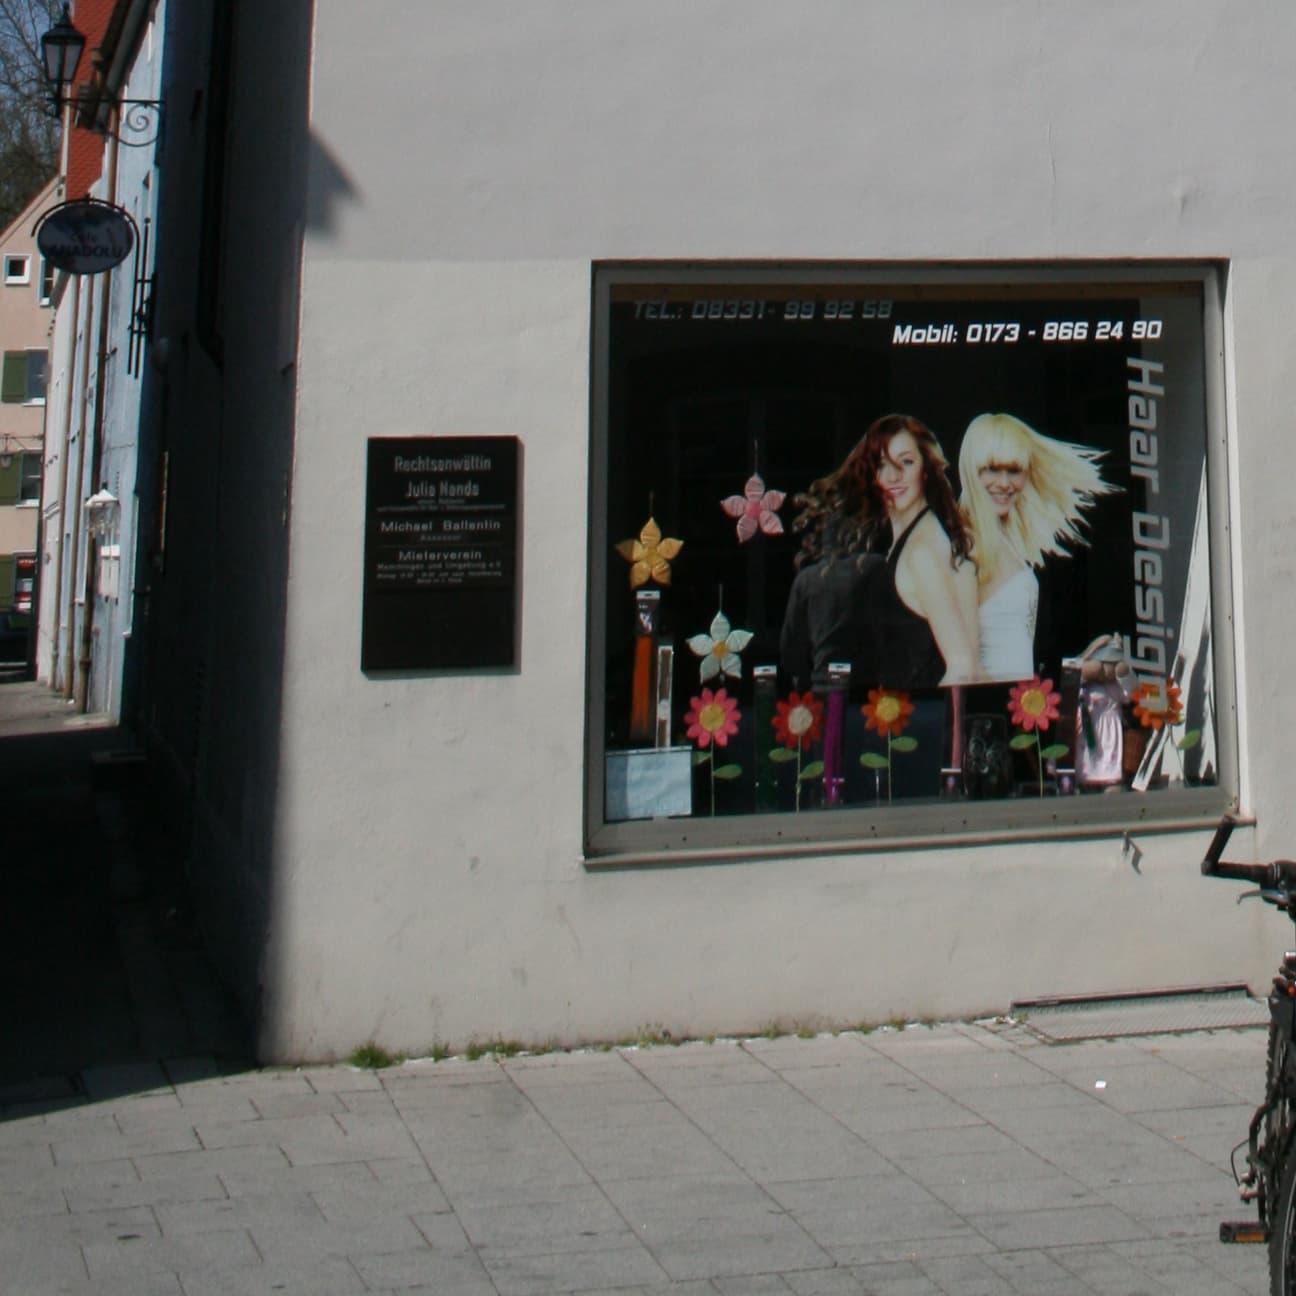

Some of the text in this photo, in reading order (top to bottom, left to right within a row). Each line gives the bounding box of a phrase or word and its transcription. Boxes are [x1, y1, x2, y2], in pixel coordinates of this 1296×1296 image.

[783, 299, 814, 320] 99
[823, 299, 854, 320] 92
[861, 299, 894, 319] 58
[891, 322, 960, 345] Mobil:
[966, 322, 1021, 343] 0173
[1042, 320, 1089, 342] 866
[1094, 319, 1125, 341] 24
[1131, 319, 1164, 340] 90
[406, 481, 437, 497] Julia
[380, 521, 433, 532] Michael
[1124, 356, 1174, 711] Haar Design
[398, 550, 483, 561] Mieterverein
